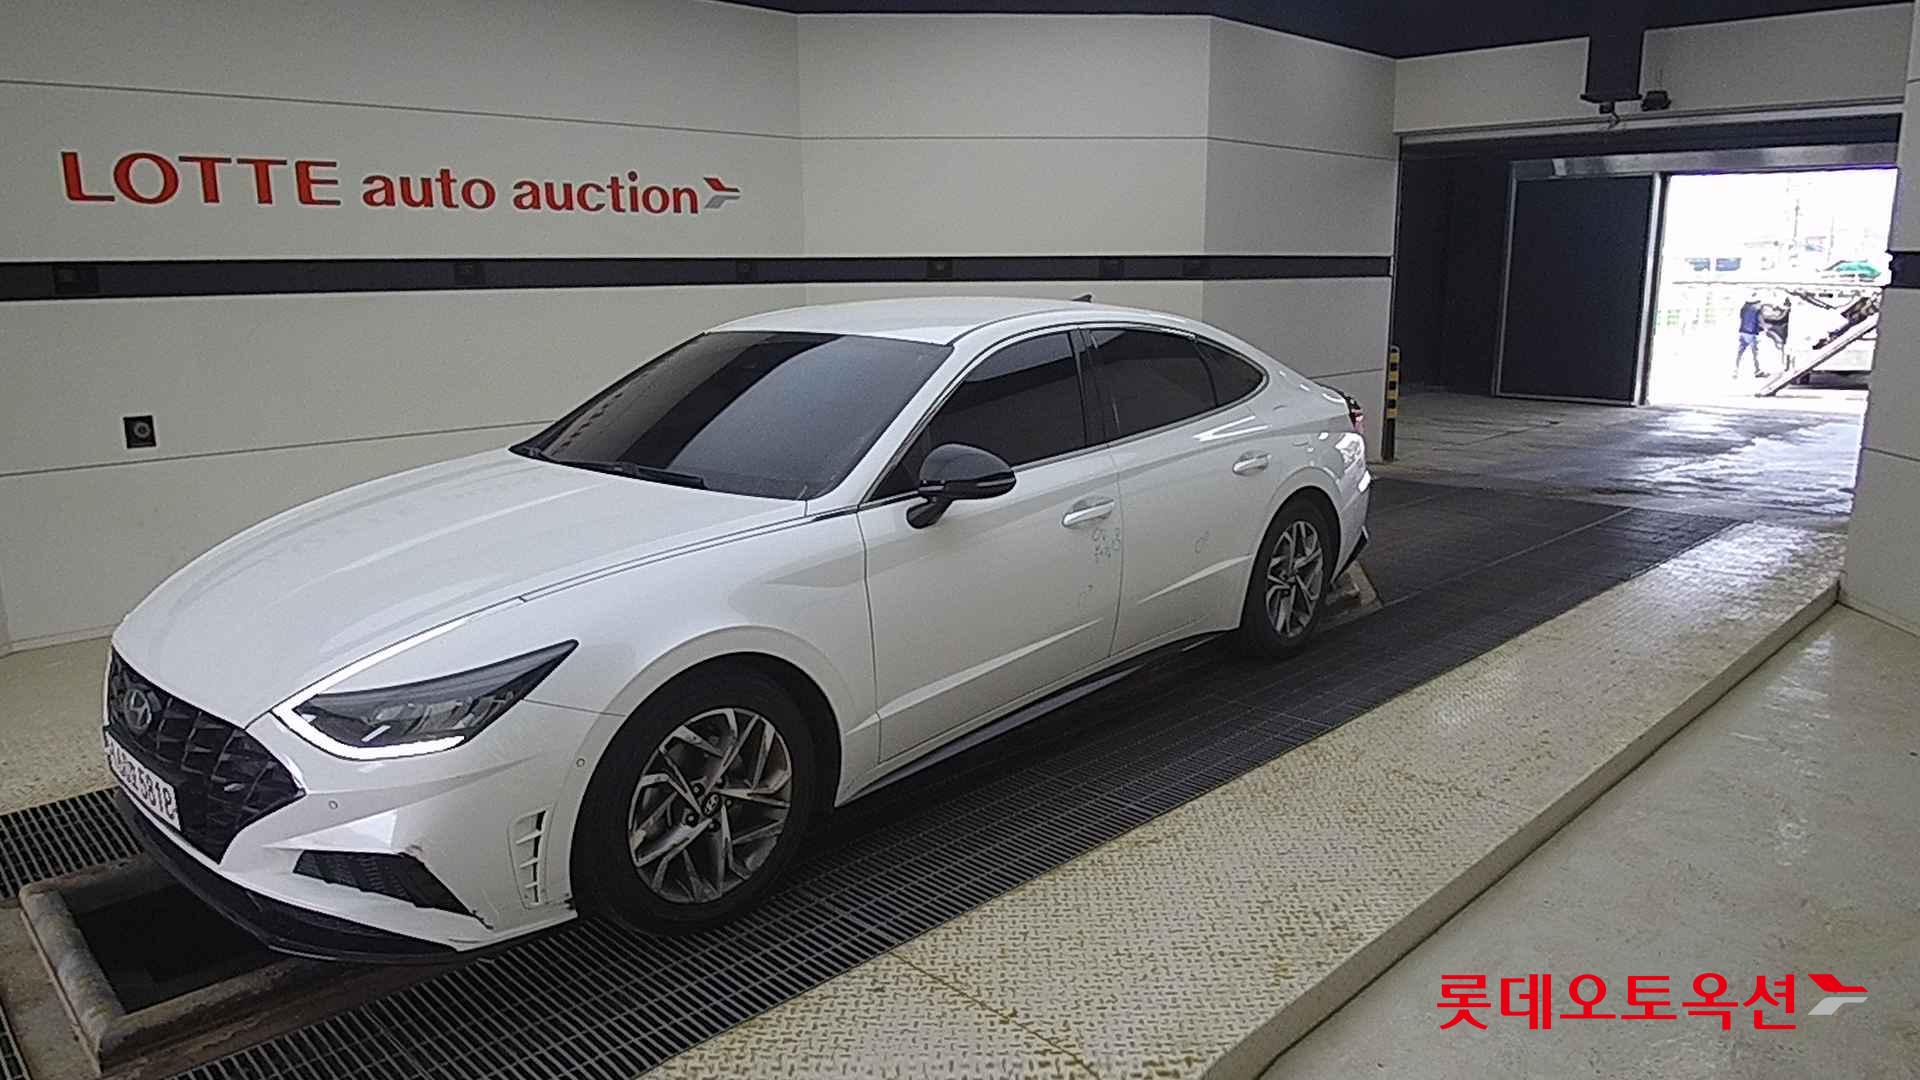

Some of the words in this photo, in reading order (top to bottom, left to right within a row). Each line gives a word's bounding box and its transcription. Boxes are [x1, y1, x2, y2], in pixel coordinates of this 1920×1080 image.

[62, 151, 341, 206] LOTTE
[363, 168, 496, 210] auto
[512, 171, 699, 215] auction
